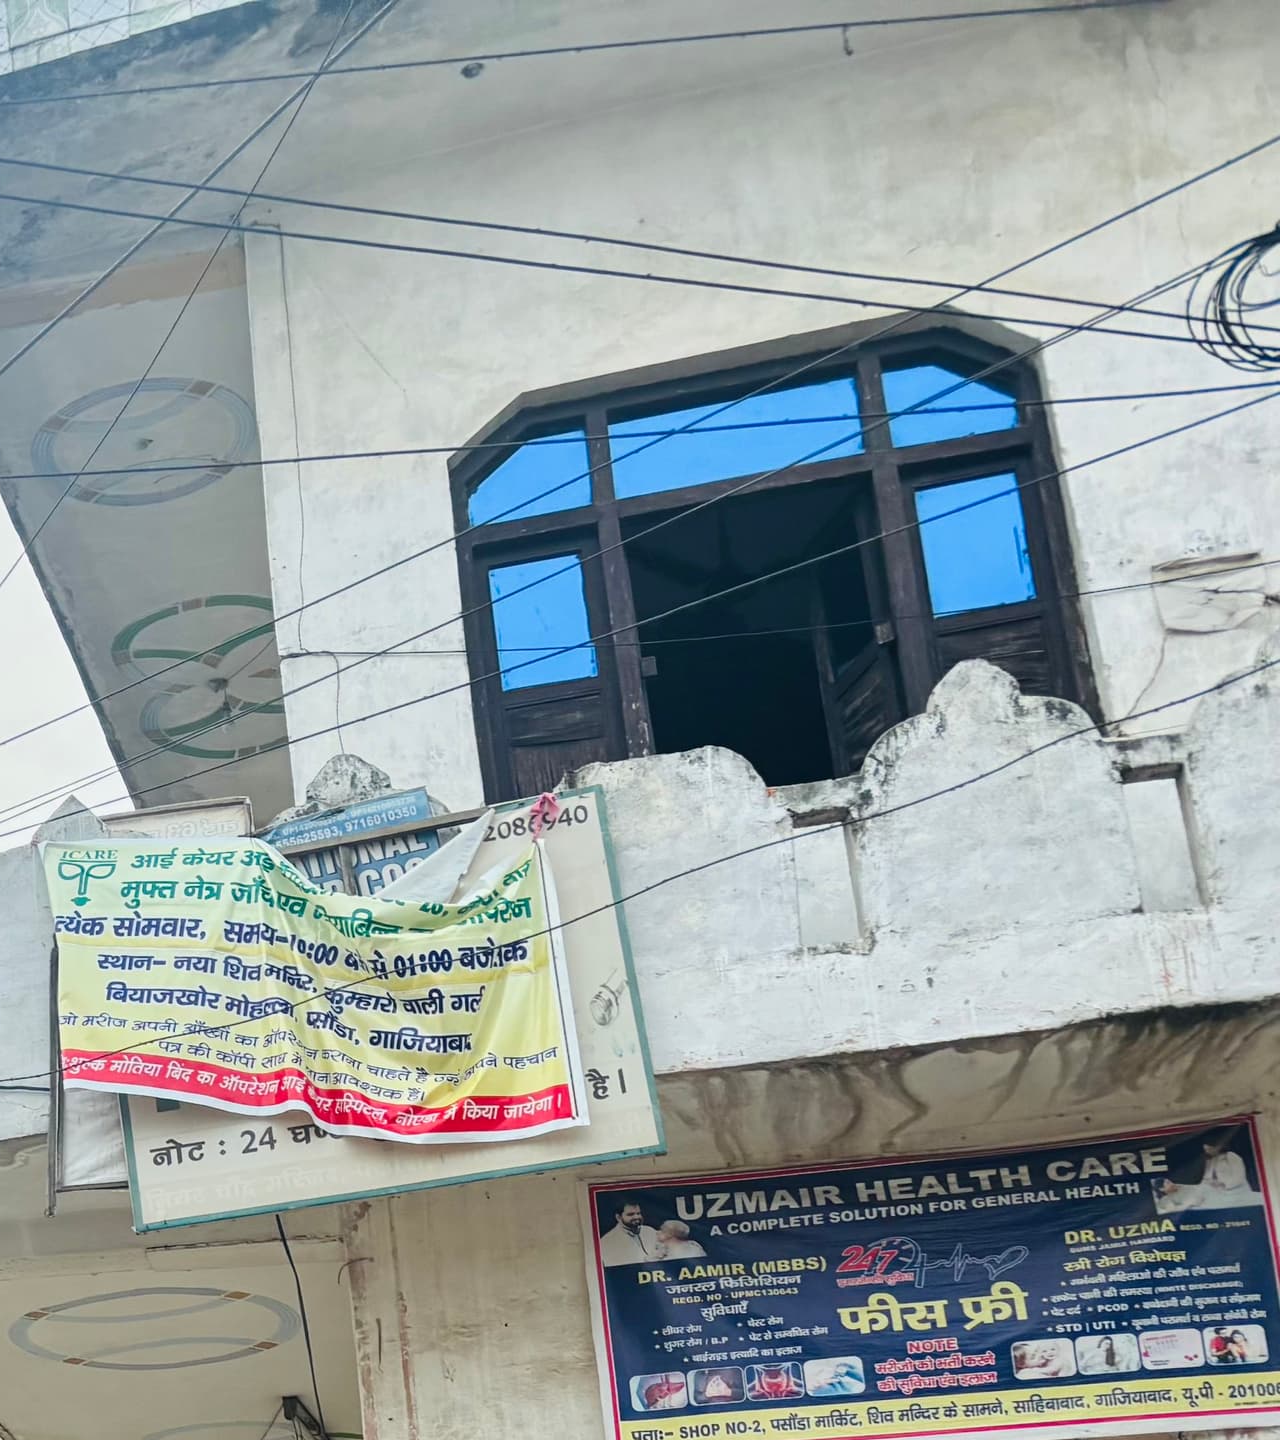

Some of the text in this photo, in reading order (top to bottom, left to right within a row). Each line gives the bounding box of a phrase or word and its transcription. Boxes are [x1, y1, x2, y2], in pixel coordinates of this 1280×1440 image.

[344, 805, 418, 833] 9716010350
[130, 847, 236, 870] आई केयर
[120, 880, 178, 909] मुफ्त
[183, 875, 225, 900] नेत्र
[113, 911, 207, 940] सोमवार,
[393, 949, 453, 979] 01:00
[106, 981, 222, 1009] बियाजखोर
[173, 956, 218, 974] नया
[223, 955, 262, 982] शिव
[403, 985, 445, 1015] वाली
[82, 1012, 129, 1029] मरीज
[131, 1017, 179, 1034] अपनी
[234, 1033, 260, 1049] का
[367, 1062, 411, 1083] चाहते
[503, 1046, 560, 1071] पहचान
[158, 1039, 182, 1056] पत्र
[186, 1041, 211, 1060] की
[108, 1054, 163, 1077] मोतिया
[165, 1057, 194, 1082] बिंद
[196, 1068, 217, 1087] का
[219, 1071, 280, 1096] ऑपरेशन
[463, 1100, 499, 1122] किया
[502, 1093, 553, 1119] जायेगा
[149, 1137, 206, 1169] नोट
[240, 1126, 278, 1156] 24
[675, 1146, 1170, 1221] UZMAIR HEALTH CARE
[709, 1180, 1141, 1238] A COMPLETE SOLUTION FOR GENERAL HEALTH
[1064, 1230, 1103, 1245] DR.
[1109, 1218, 1177, 1239] UZMA
[638, 1255, 828, 1284] DR. AAMIR (MBBS)
[1095, 1253, 1126, 1269] रोग
[706, 1293, 722, 1301] NO
[836, 1292, 949, 1335] फीस
[958, 1280, 1029, 1331] फ्री
[1097, 1302, 1130, 1313] PCOD
[1055, 1323, 1083, 1334] STD
[1092, 1320, 1117, 1331] UTI
[907, 1337, 959, 1354] NOTE
[915, 1356, 935, 1372] को
[877, 1377, 898, 1392] की
[959, 1371, 998, 1388] इलाज
[679, 1423, 721, 1440] SHOP
[725, 1419, 767, 1436] NO-2,
[867, 1406, 895, 1425] शिव
[942, 1400, 958, 1419] के
[962, 1399, 1009, 1418] सामने,
